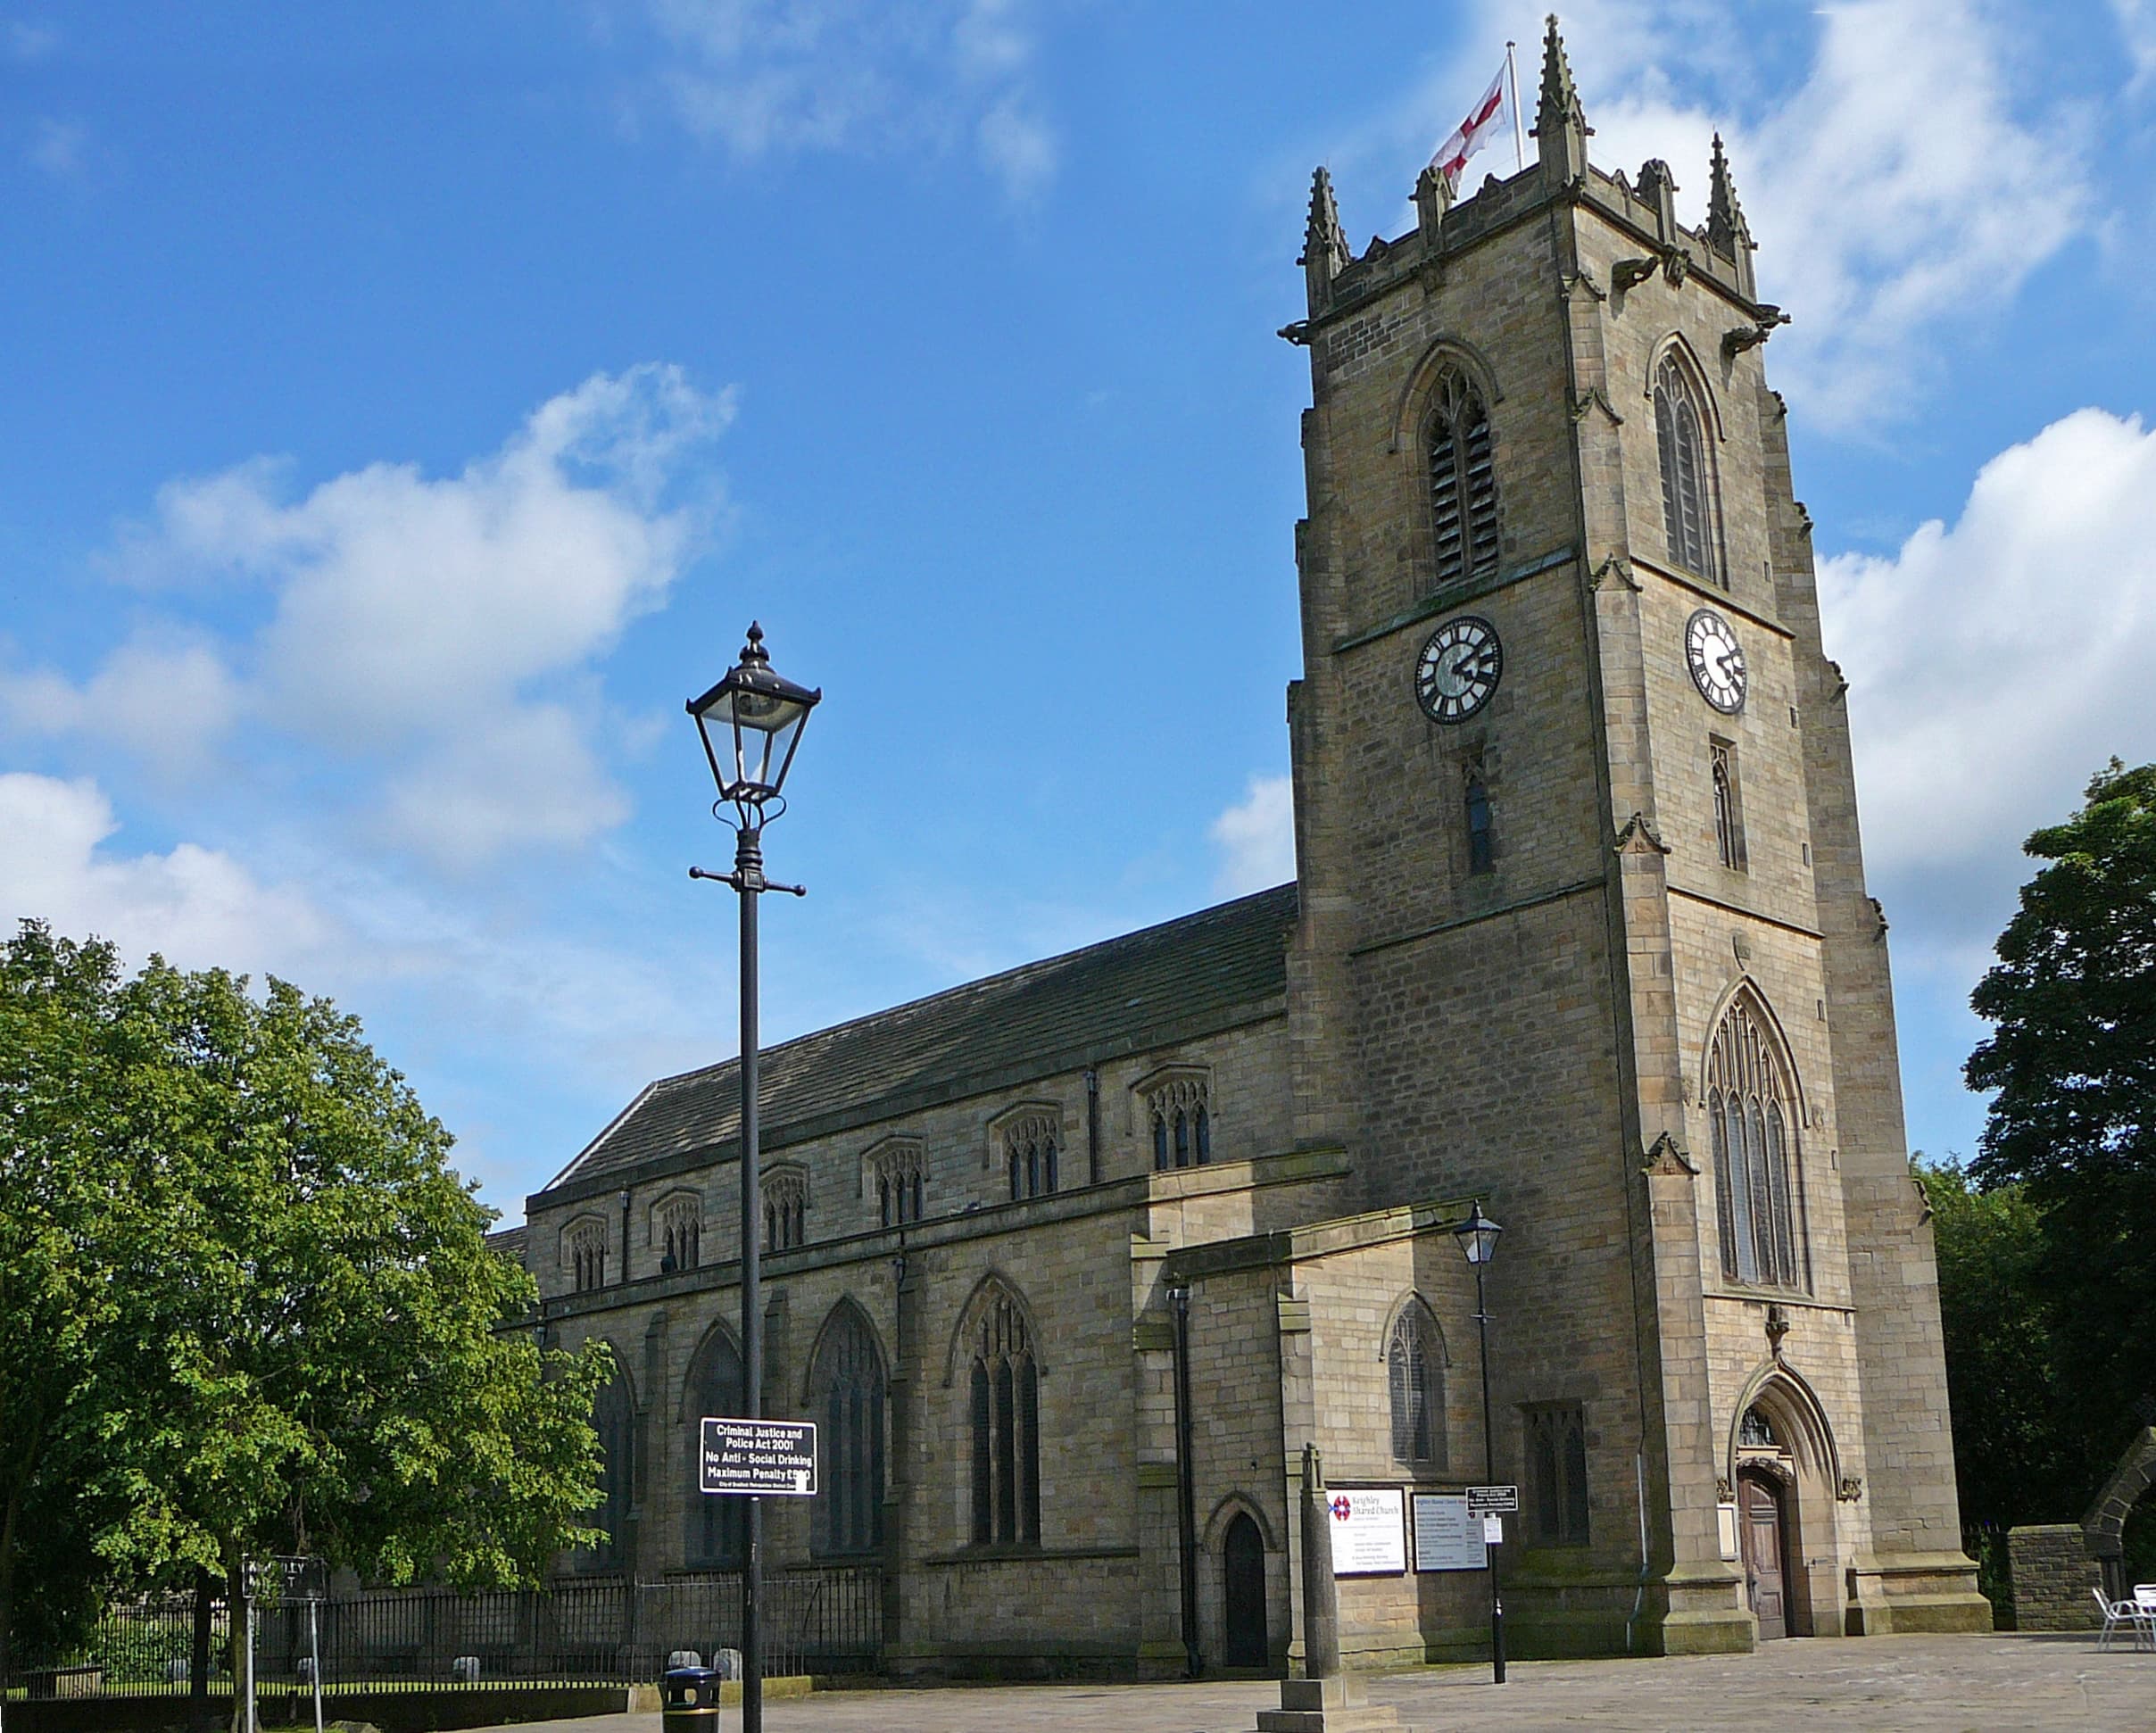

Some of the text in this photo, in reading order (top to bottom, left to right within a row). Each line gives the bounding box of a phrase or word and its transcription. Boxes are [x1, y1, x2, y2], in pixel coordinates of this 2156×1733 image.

[717, 1424, 803, 1439] Criminal Justice and
[726, 1437, 794, 1451] Police Act 2001
[705, 1451, 719, 1463] No
[722, 1452, 741, 1464] Anti
[748, 1453, 776, 1465] Social
[777, 1454, 813, 1468] Drinking
[708, 1466, 750, 1479] Maximum
[752, 1468, 786, 1482] Penalty
[1352, 1495, 1380, 1507] Keighley
[1353, 1505, 1399, 1515] Shared Church
